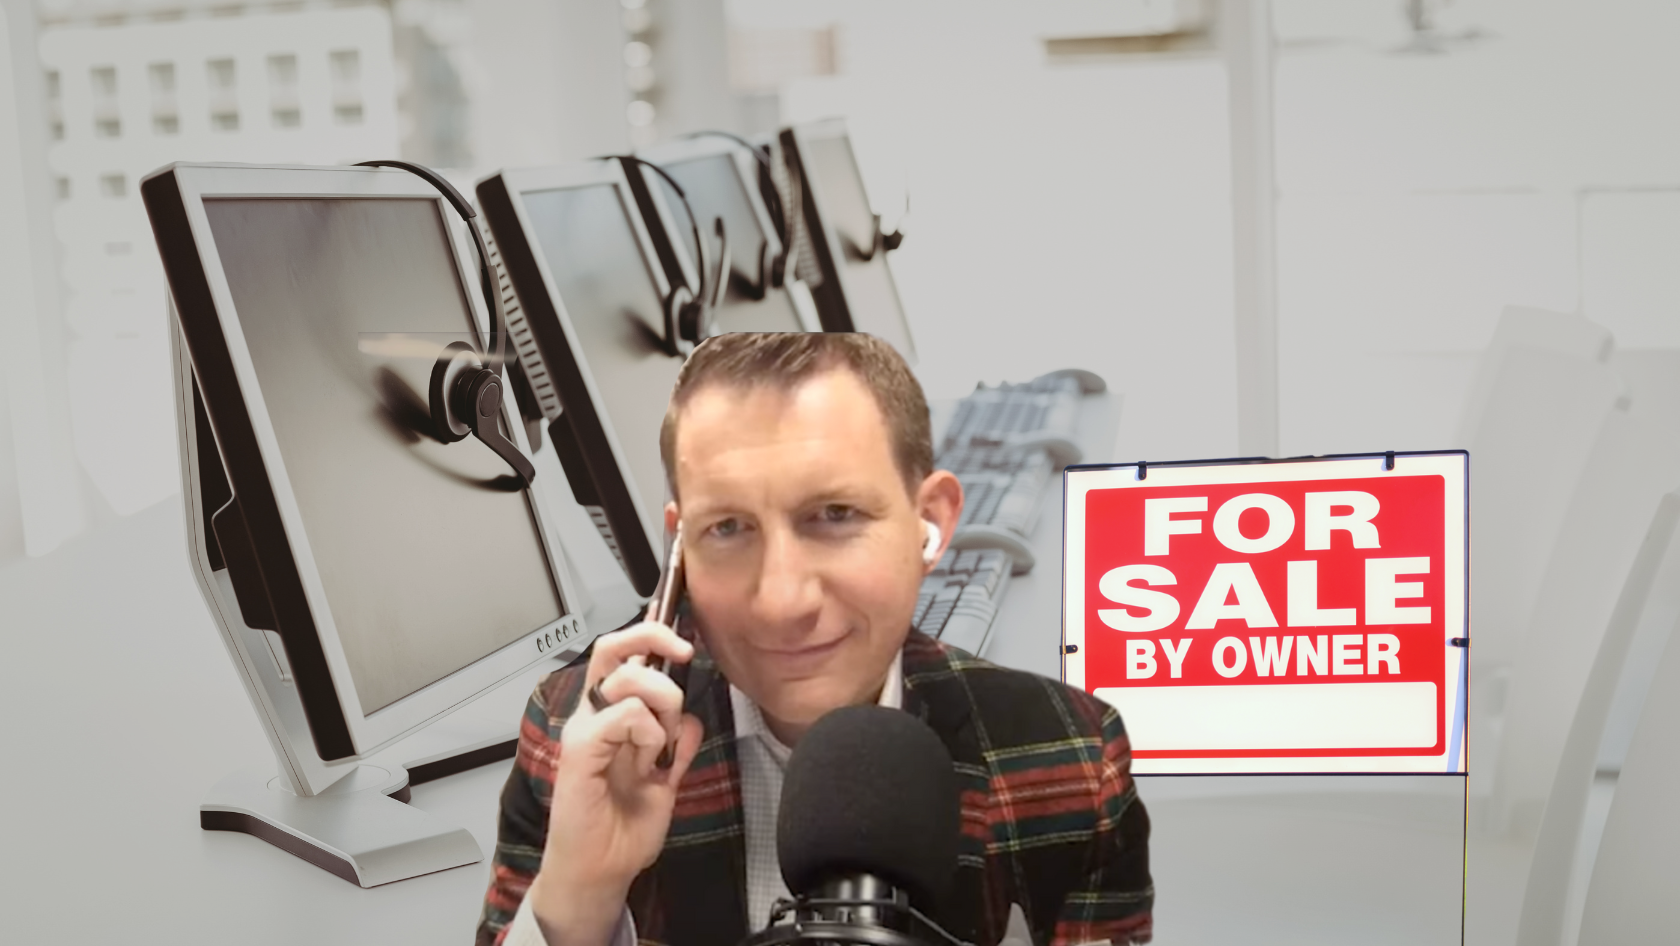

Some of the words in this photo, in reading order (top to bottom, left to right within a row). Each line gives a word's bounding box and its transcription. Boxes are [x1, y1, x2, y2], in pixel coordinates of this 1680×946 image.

[1144, 490, 1381, 556] FOR
[1097, 556, 1432, 632] SALE
[1125, 637, 1193, 679] BY
[1211, 633, 1401, 678] OWNER
